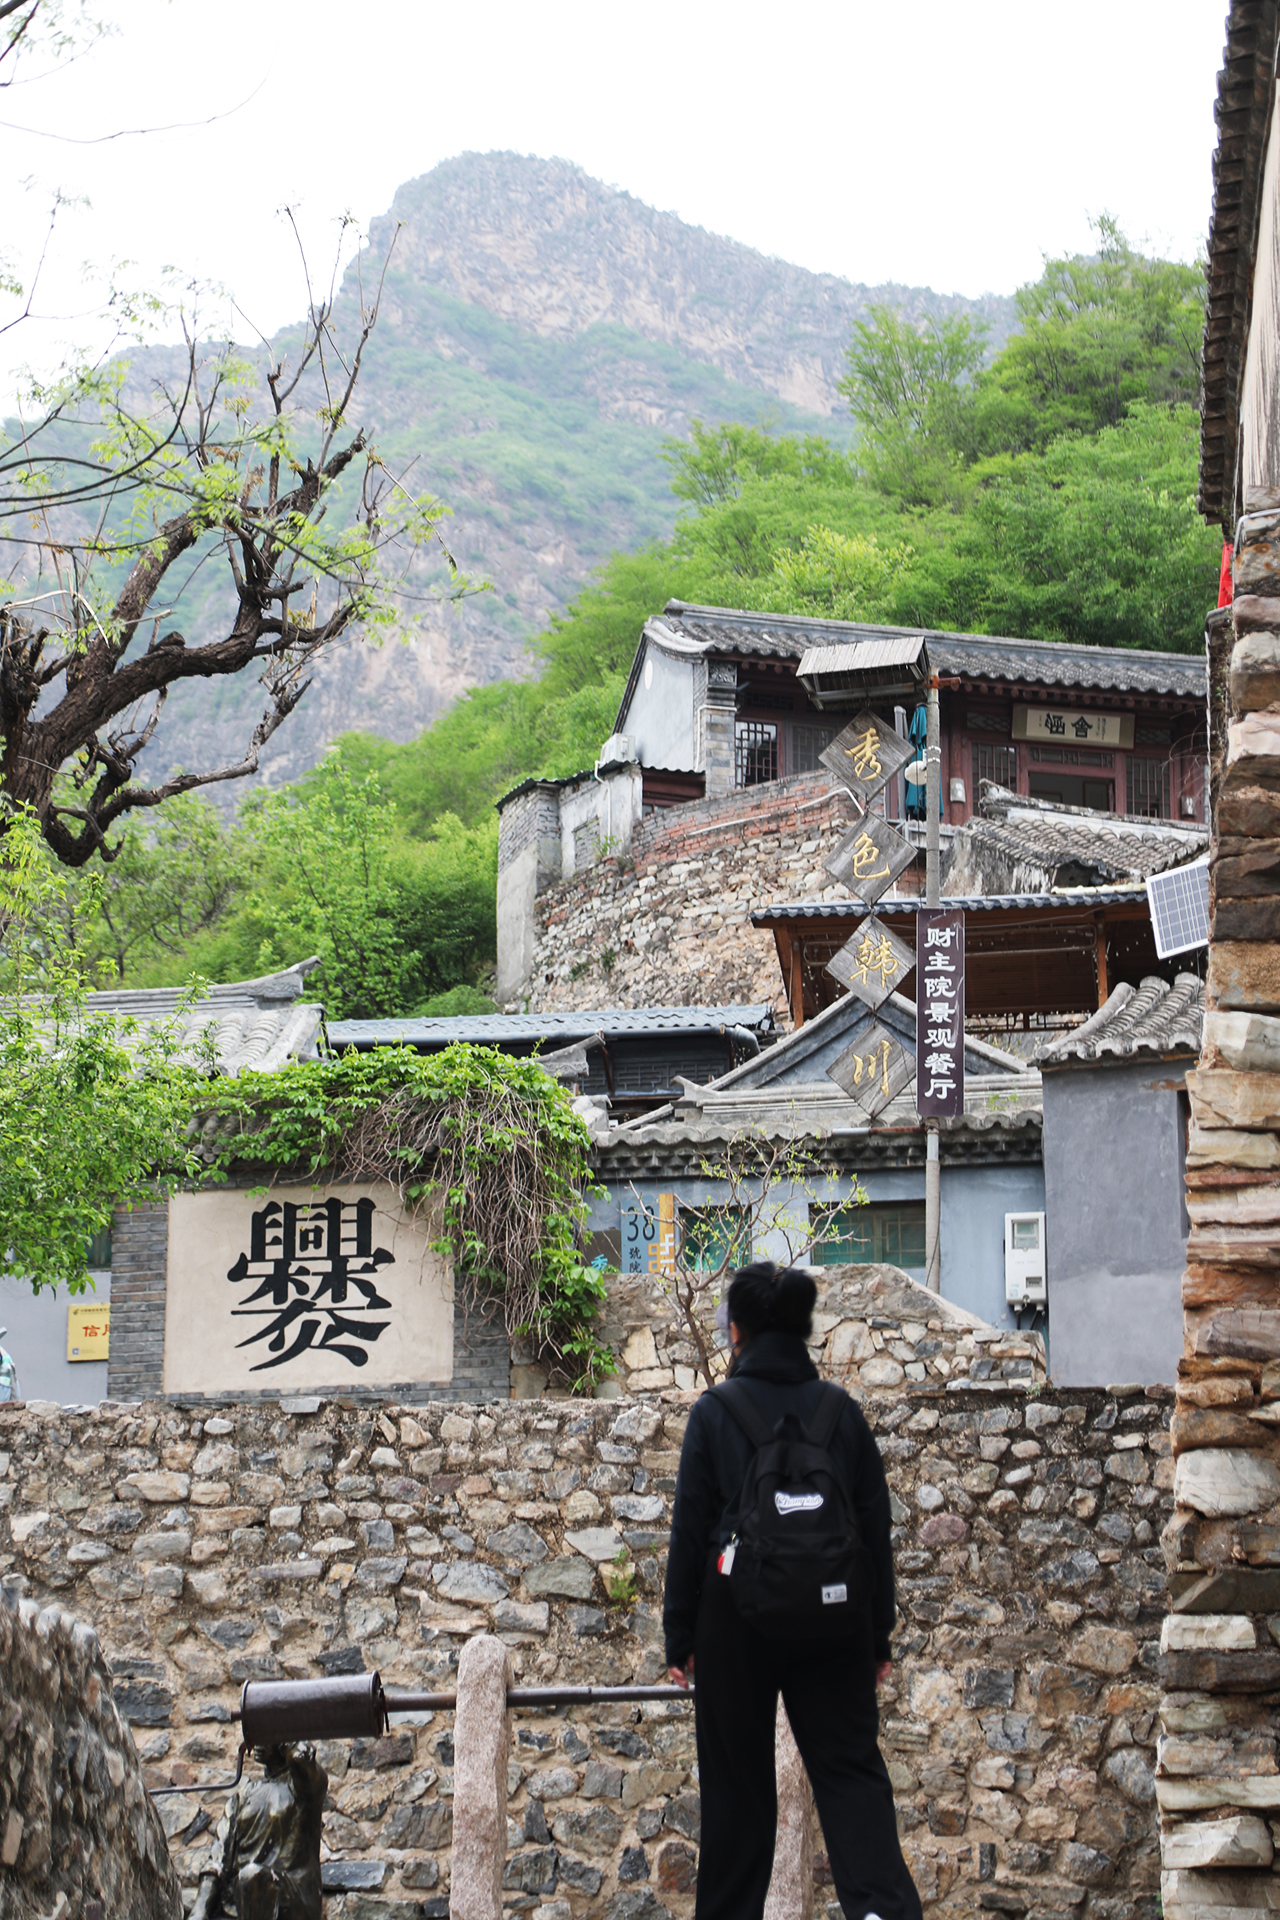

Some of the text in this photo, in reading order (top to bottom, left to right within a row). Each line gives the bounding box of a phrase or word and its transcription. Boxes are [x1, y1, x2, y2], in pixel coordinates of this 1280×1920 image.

[923, 927, 957, 1100] 财主院景观餐厅
[627, 1205, 656, 1242] 38
[227, 1197, 396, 1372] 爨
[775, 1491, 823, 1509] Champion
